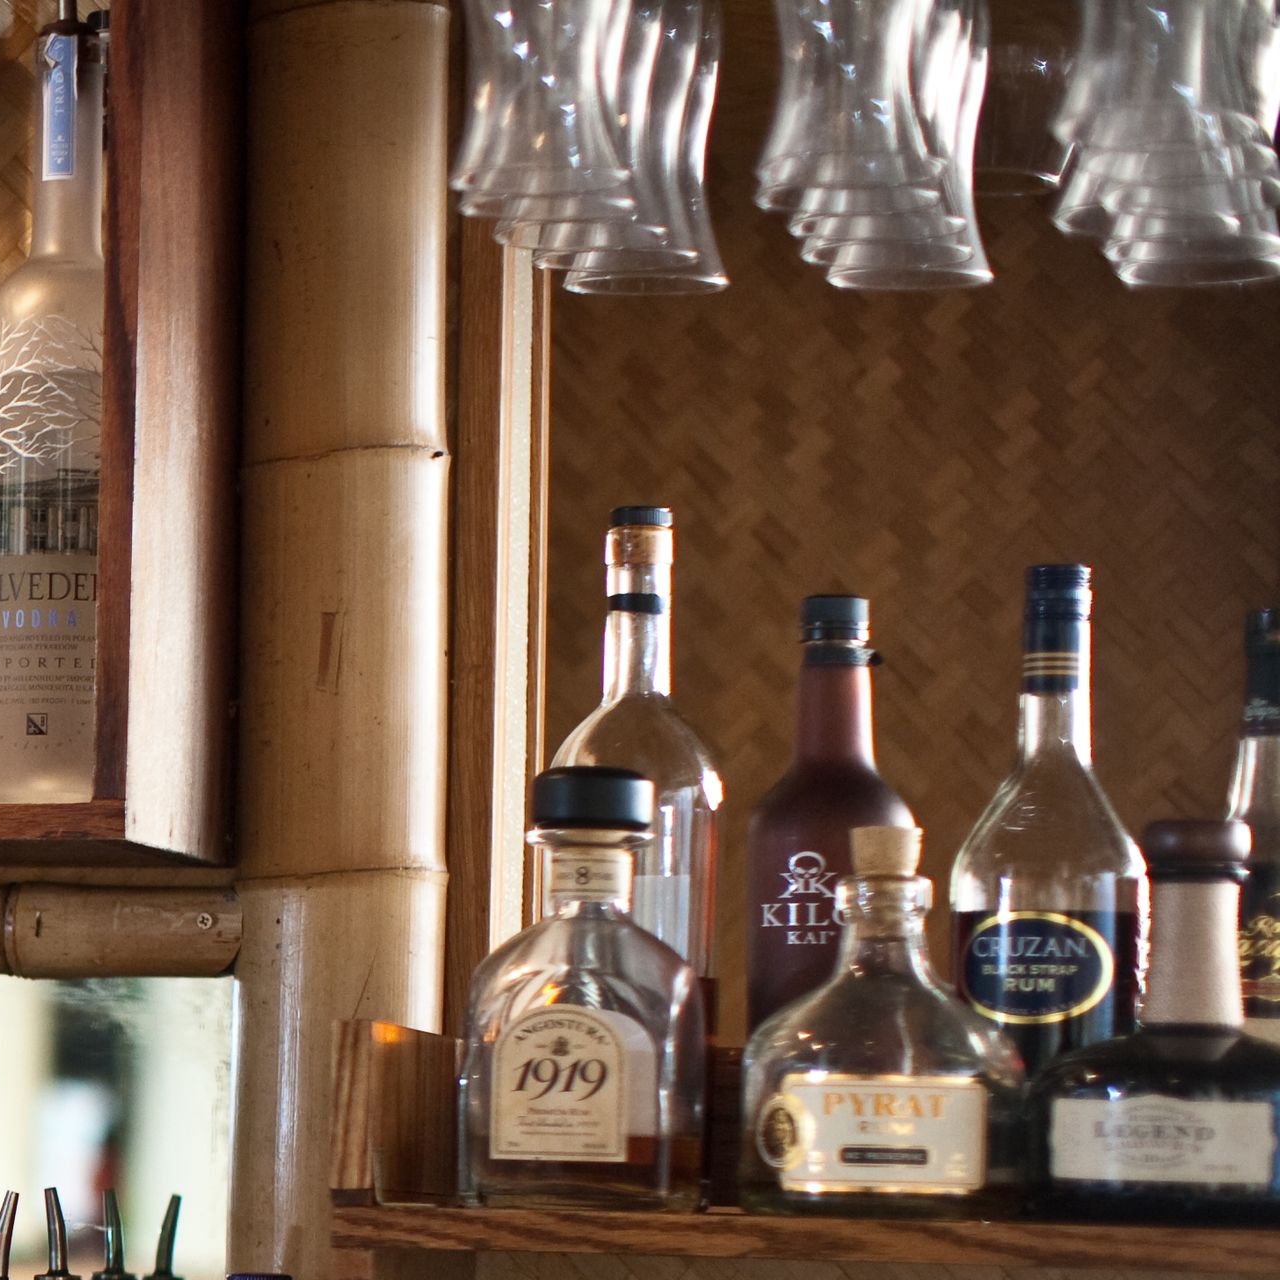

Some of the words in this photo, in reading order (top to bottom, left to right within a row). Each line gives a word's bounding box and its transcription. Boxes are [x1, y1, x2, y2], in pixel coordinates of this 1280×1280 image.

[2, 608, 77, 630] VODKA
[972, 936, 1088, 958] CRUZAN
[1029, 964, 1079, 977] STRAP
[1002, 977, 1057, 992] RUM
[514, 1018, 610, 1046] ANGOSTURA
[510, 1058, 609, 1102] 1919
[822, 1092, 945, 1118] PYRAT
[1094, 1120, 1217, 1142] LEGEND
